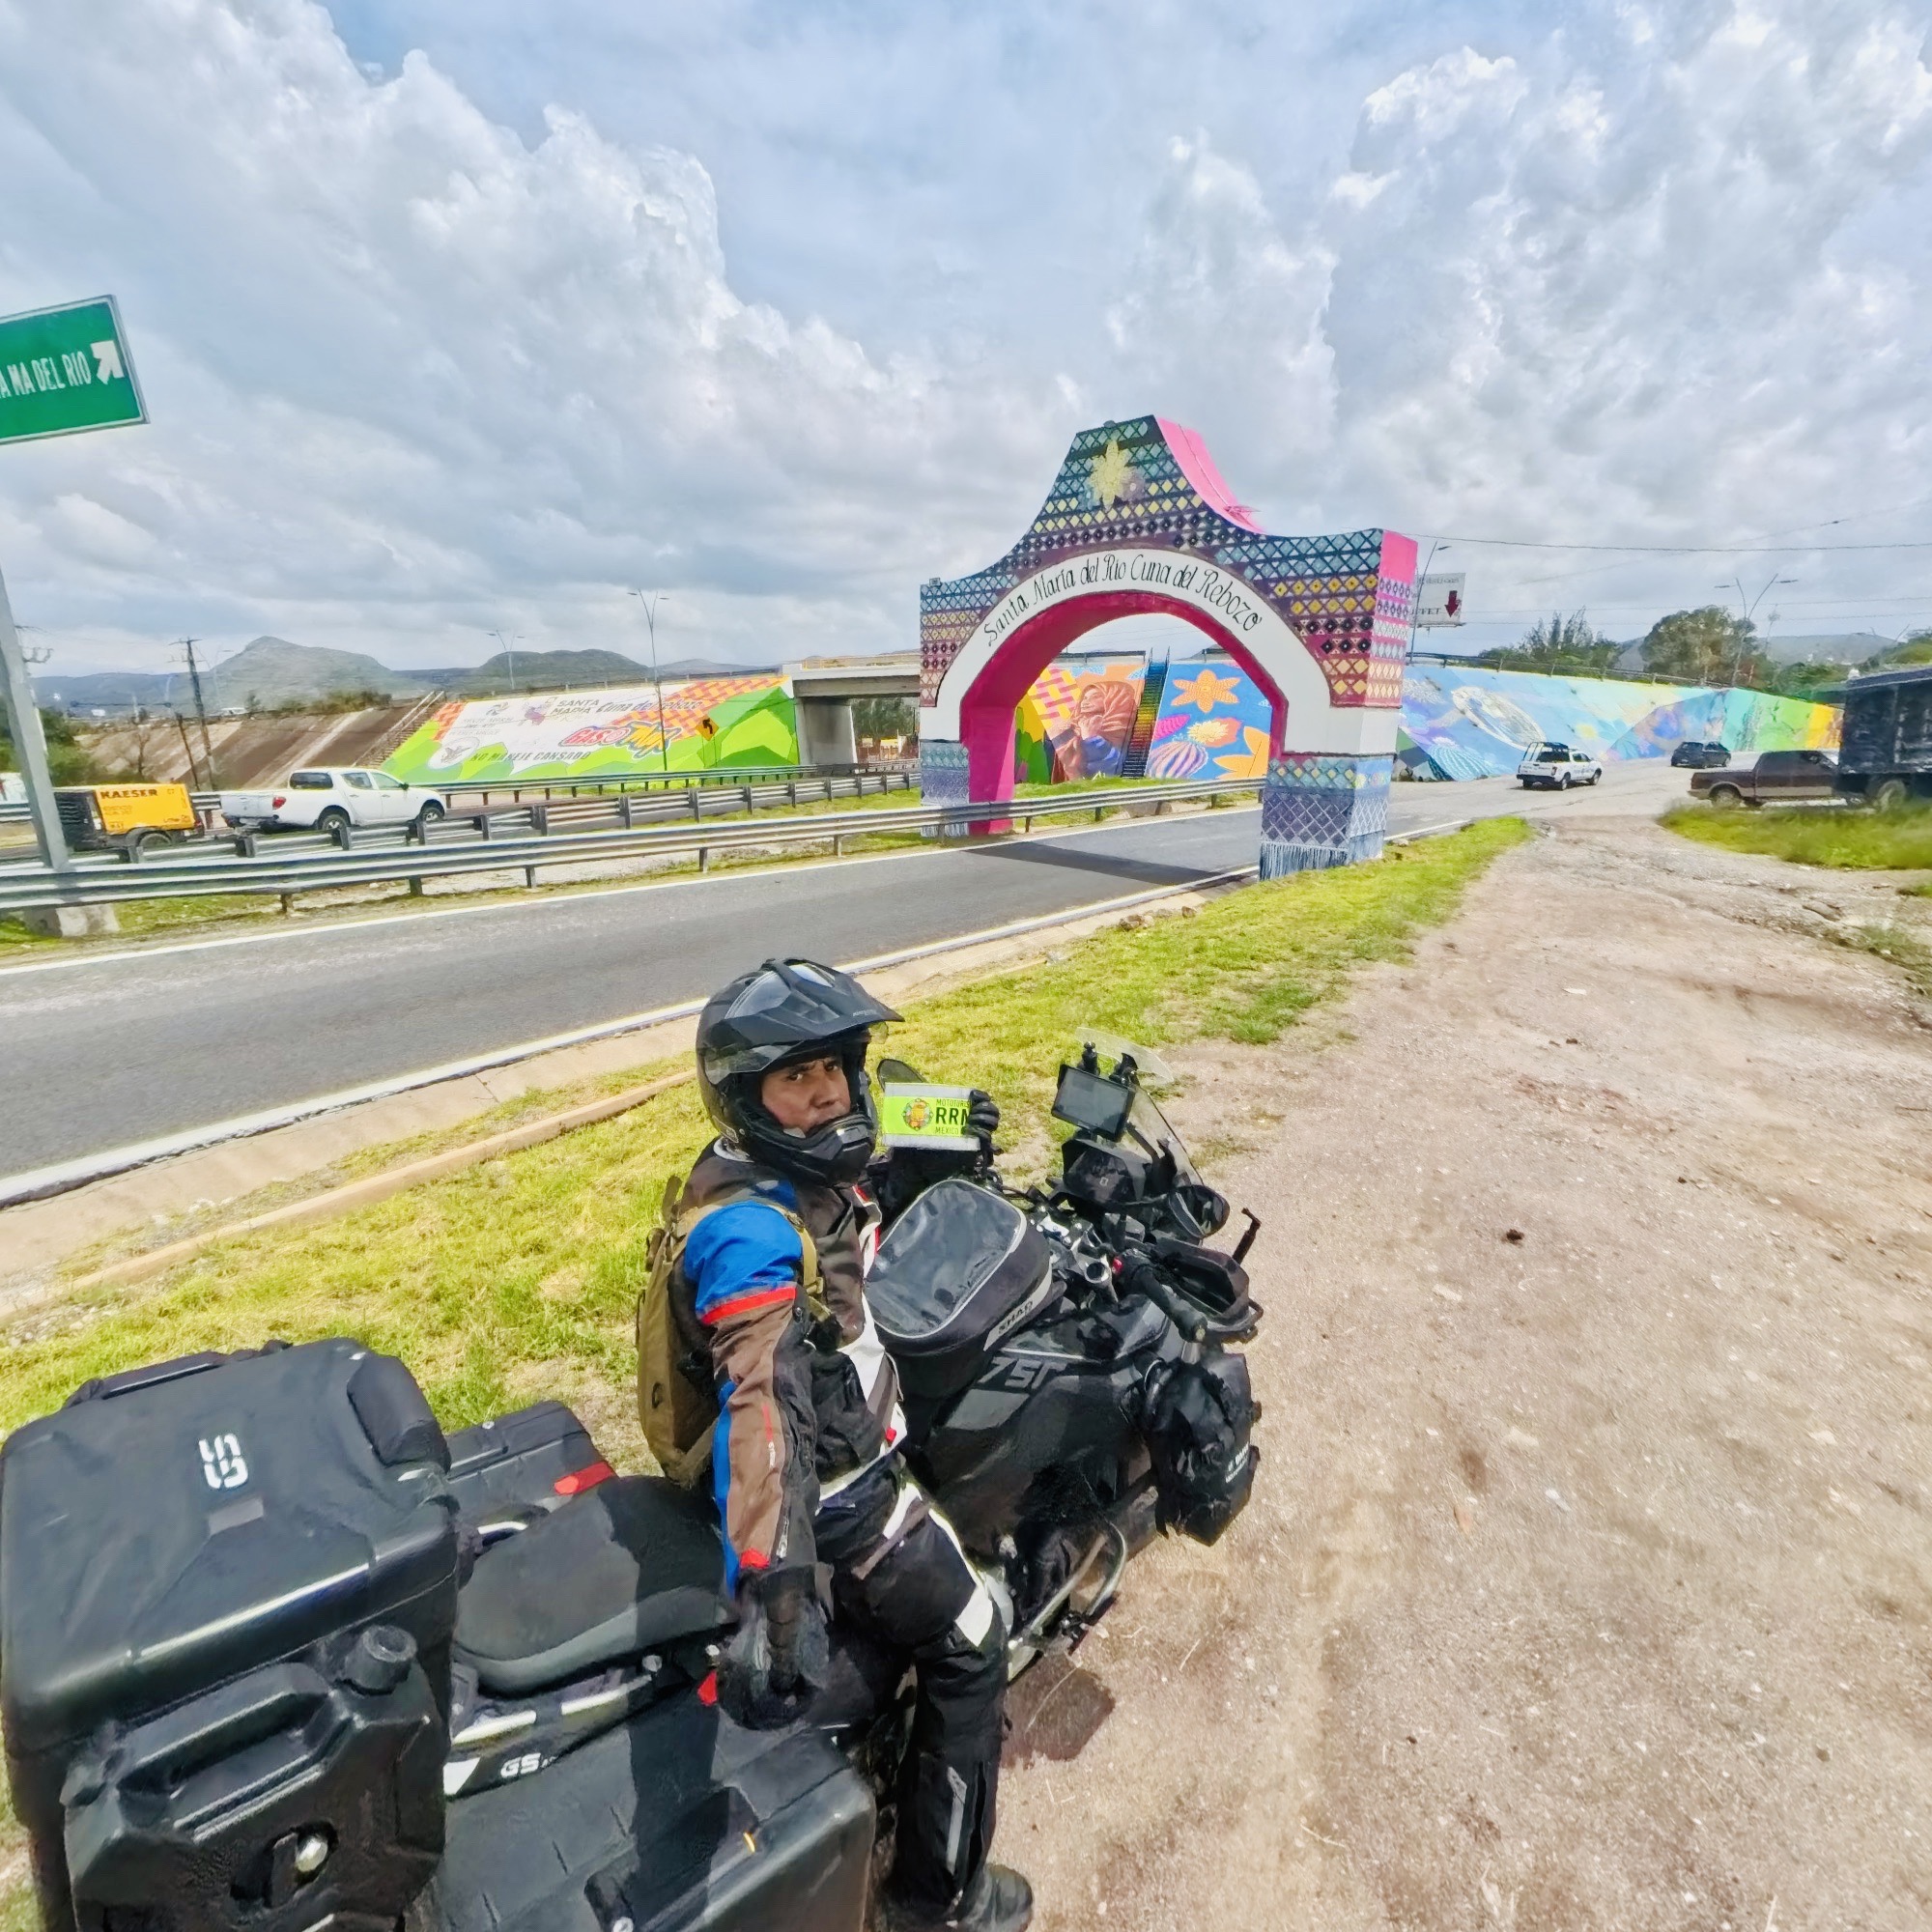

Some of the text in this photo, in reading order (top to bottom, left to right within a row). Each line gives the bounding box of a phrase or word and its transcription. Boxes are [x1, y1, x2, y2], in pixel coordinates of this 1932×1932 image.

[31, 356, 66, 392] DEL
[62, 351, 92, 386] RIO
[983, 594, 1029, 647] Santa
[1080, 556, 1099, 584] del
[1130, 554, 1172, 584] Cuna
[1172, 564, 1198, 590] del
[1195, 568, 1263, 631] Rebozo
[557, 698, 600, 707] SANTA
[99, 788, 158, 800] KAESER
[500, 1752, 542, 1778] GS
